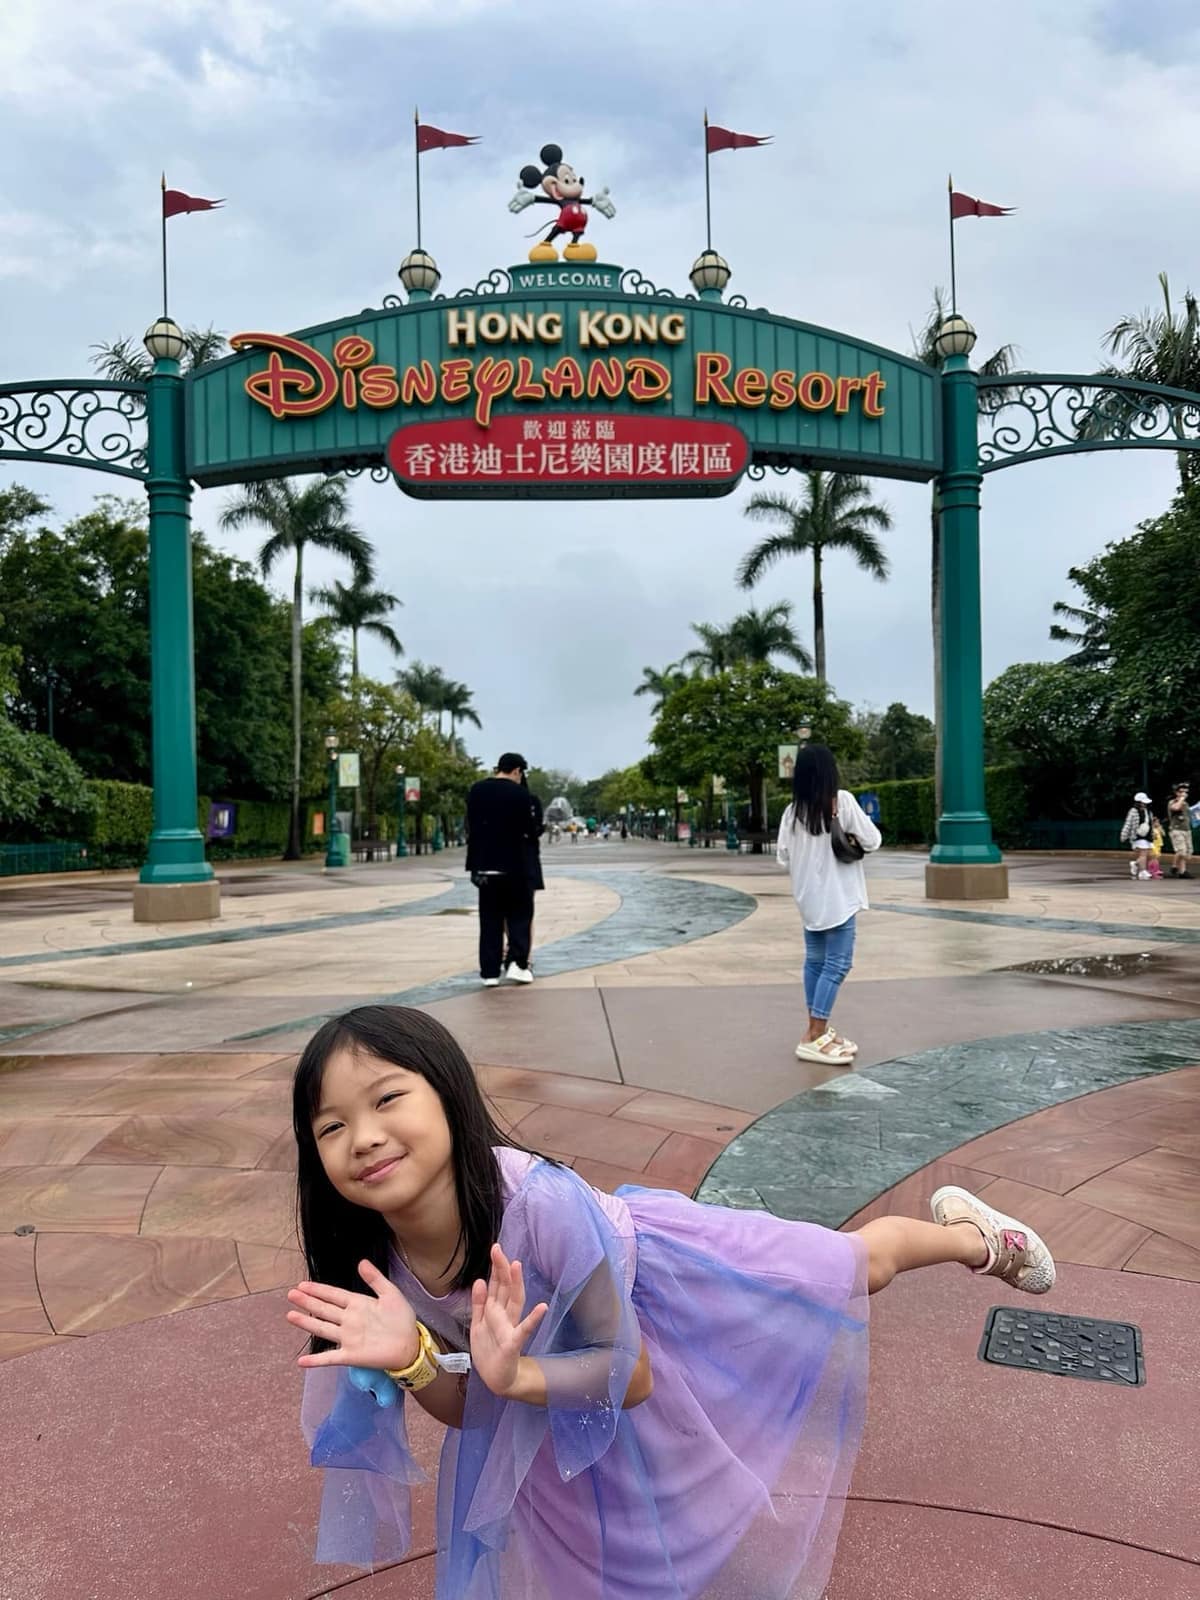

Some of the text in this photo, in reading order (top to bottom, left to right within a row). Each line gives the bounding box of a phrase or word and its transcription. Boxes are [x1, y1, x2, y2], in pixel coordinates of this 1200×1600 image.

[519, 272, 612, 288] WELCOME
[447, 309, 687, 348] HONG KONG
[696, 352, 887, 418] Resort
[523, 420, 616, 440] 歡迎蒞臨
[404, 442, 733, 476] 香港迪士尼樂園度假區
